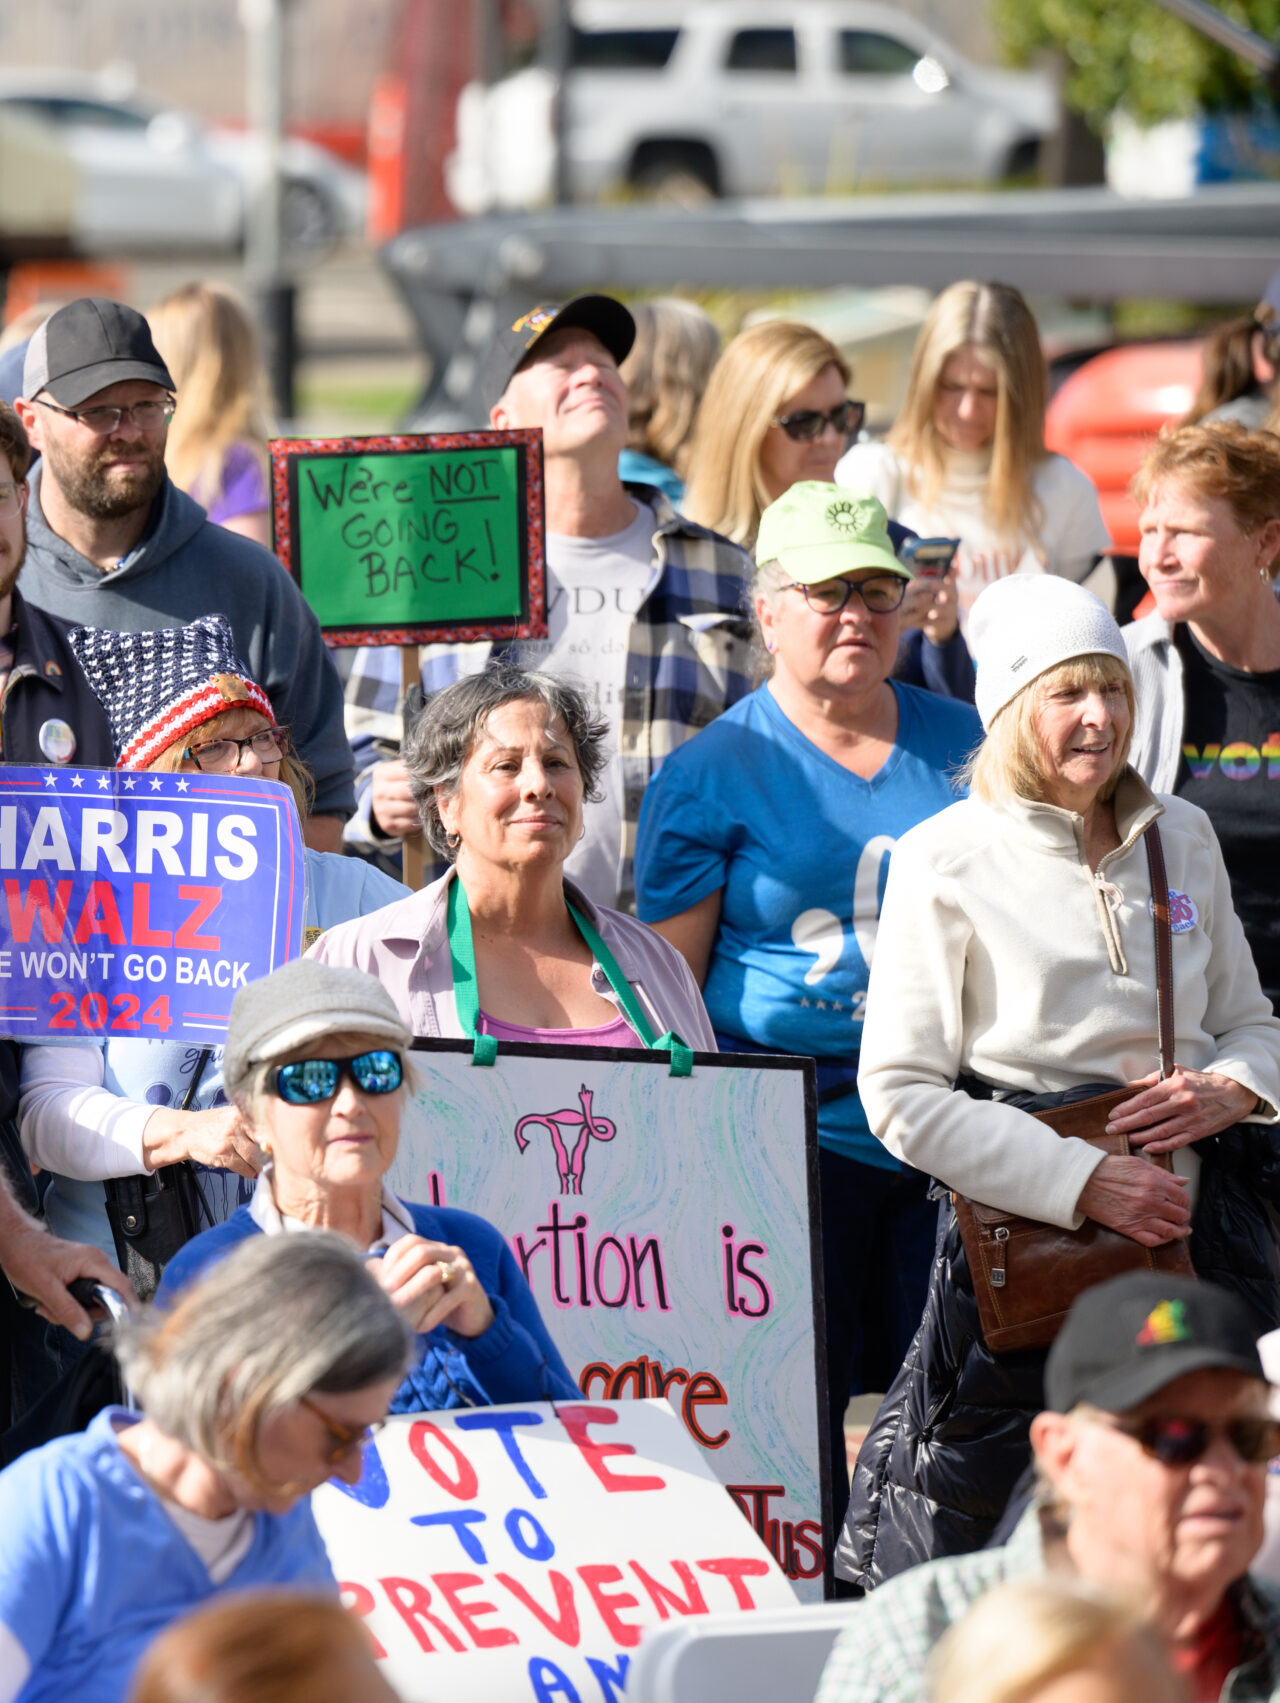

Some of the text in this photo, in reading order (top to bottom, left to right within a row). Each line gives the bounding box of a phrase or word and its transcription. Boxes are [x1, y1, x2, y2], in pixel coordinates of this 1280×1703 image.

[306, 459, 499, 511] We're NOT
[341, 508, 458, 550] GOING
[358, 519, 500, 598] BACK!
[4, 878, 222, 952] WALZ
[20, 951, 115, 981] WON'T
[123, 953, 167, 985] GO
[175, 957, 251, 989] BACK
[47, 991, 173, 1033] 2024
[719, 1222, 775, 1321] is
[410, 1508, 556, 1566] TO
